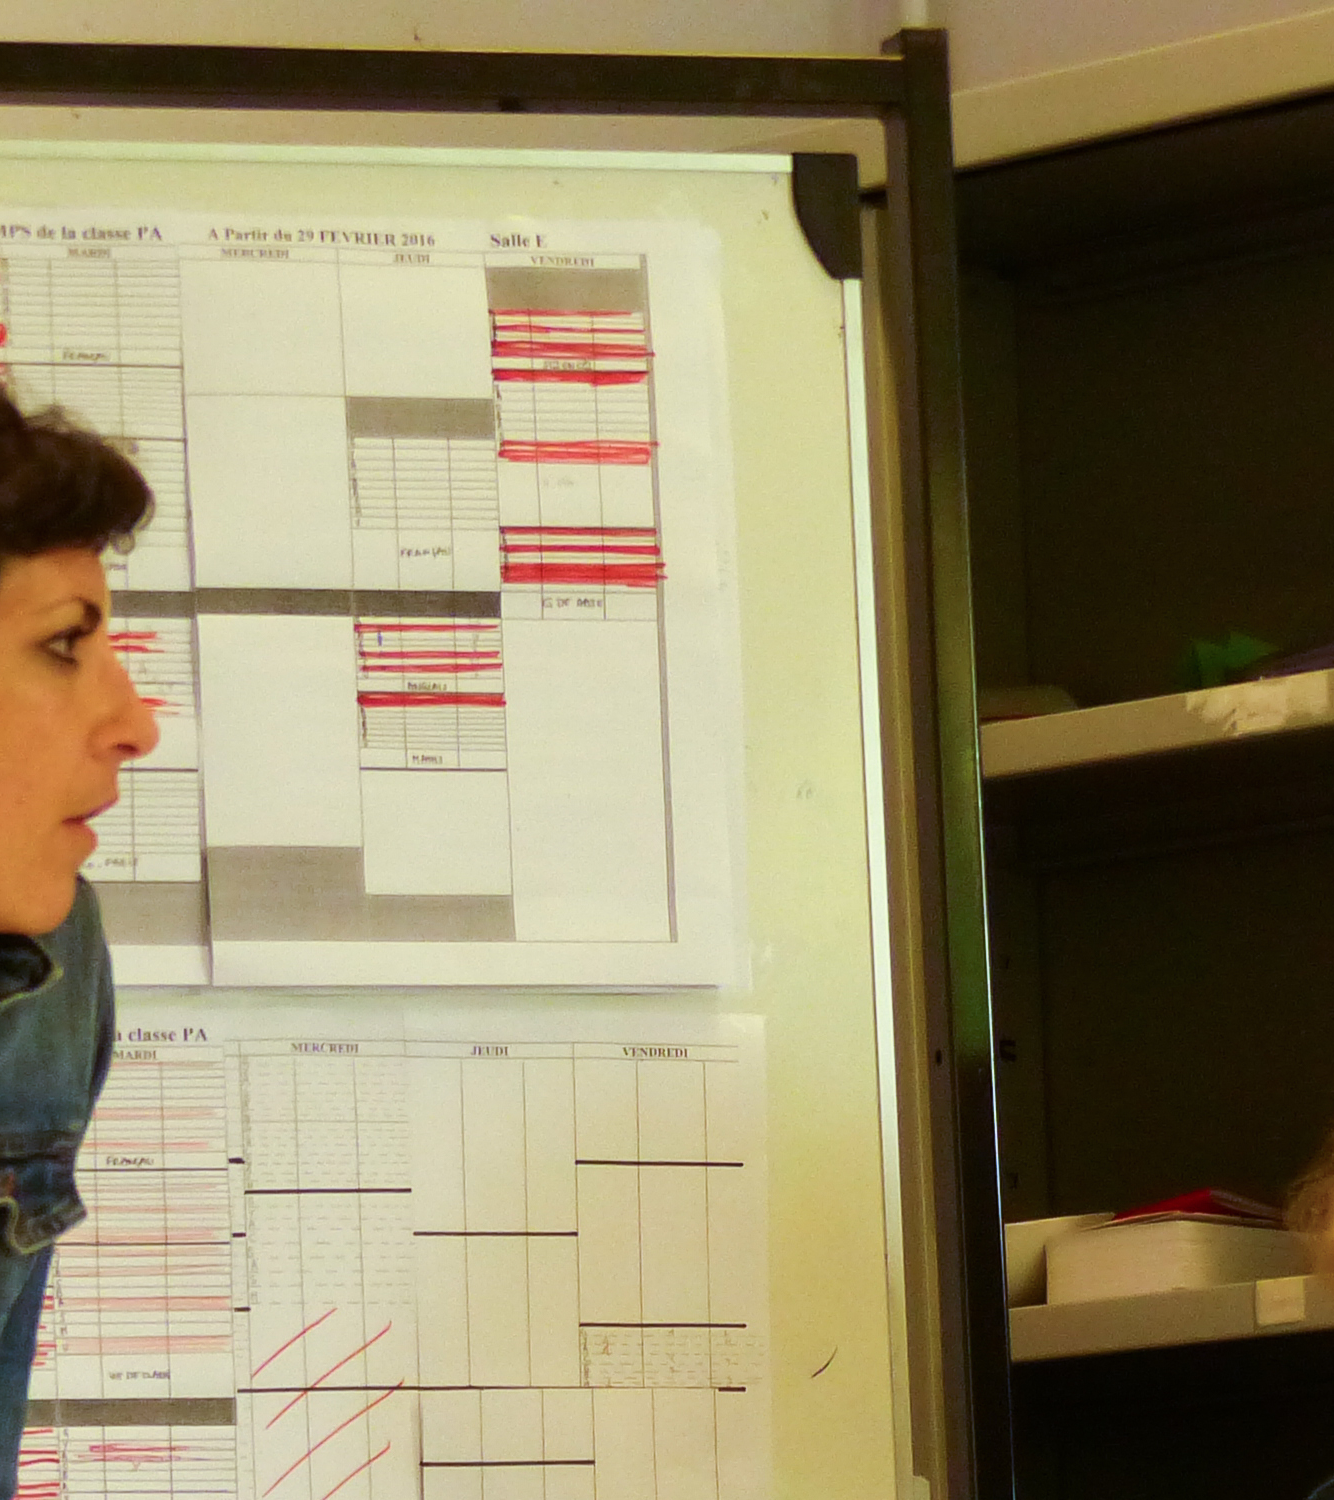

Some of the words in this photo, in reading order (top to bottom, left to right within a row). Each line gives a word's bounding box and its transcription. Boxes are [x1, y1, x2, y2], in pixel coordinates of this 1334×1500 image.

[37, 225, 56, 240] de
[82, 227, 132, 241] classe
[208, 228, 218, 241] A
[223, 228, 267, 242] Partir
[273, 229, 292, 242] du
[298, 229, 315, 243] 29
[401, 232, 436, 247] 2016
[489, 233, 530, 249] Salle
[128, 1028, 177, 1042] classe
[291, 1042, 359, 1054] MERCREDI
[471, 1045, 509, 1057] JEUDI
[622, 1046, 689, 1059] VENDREDI
